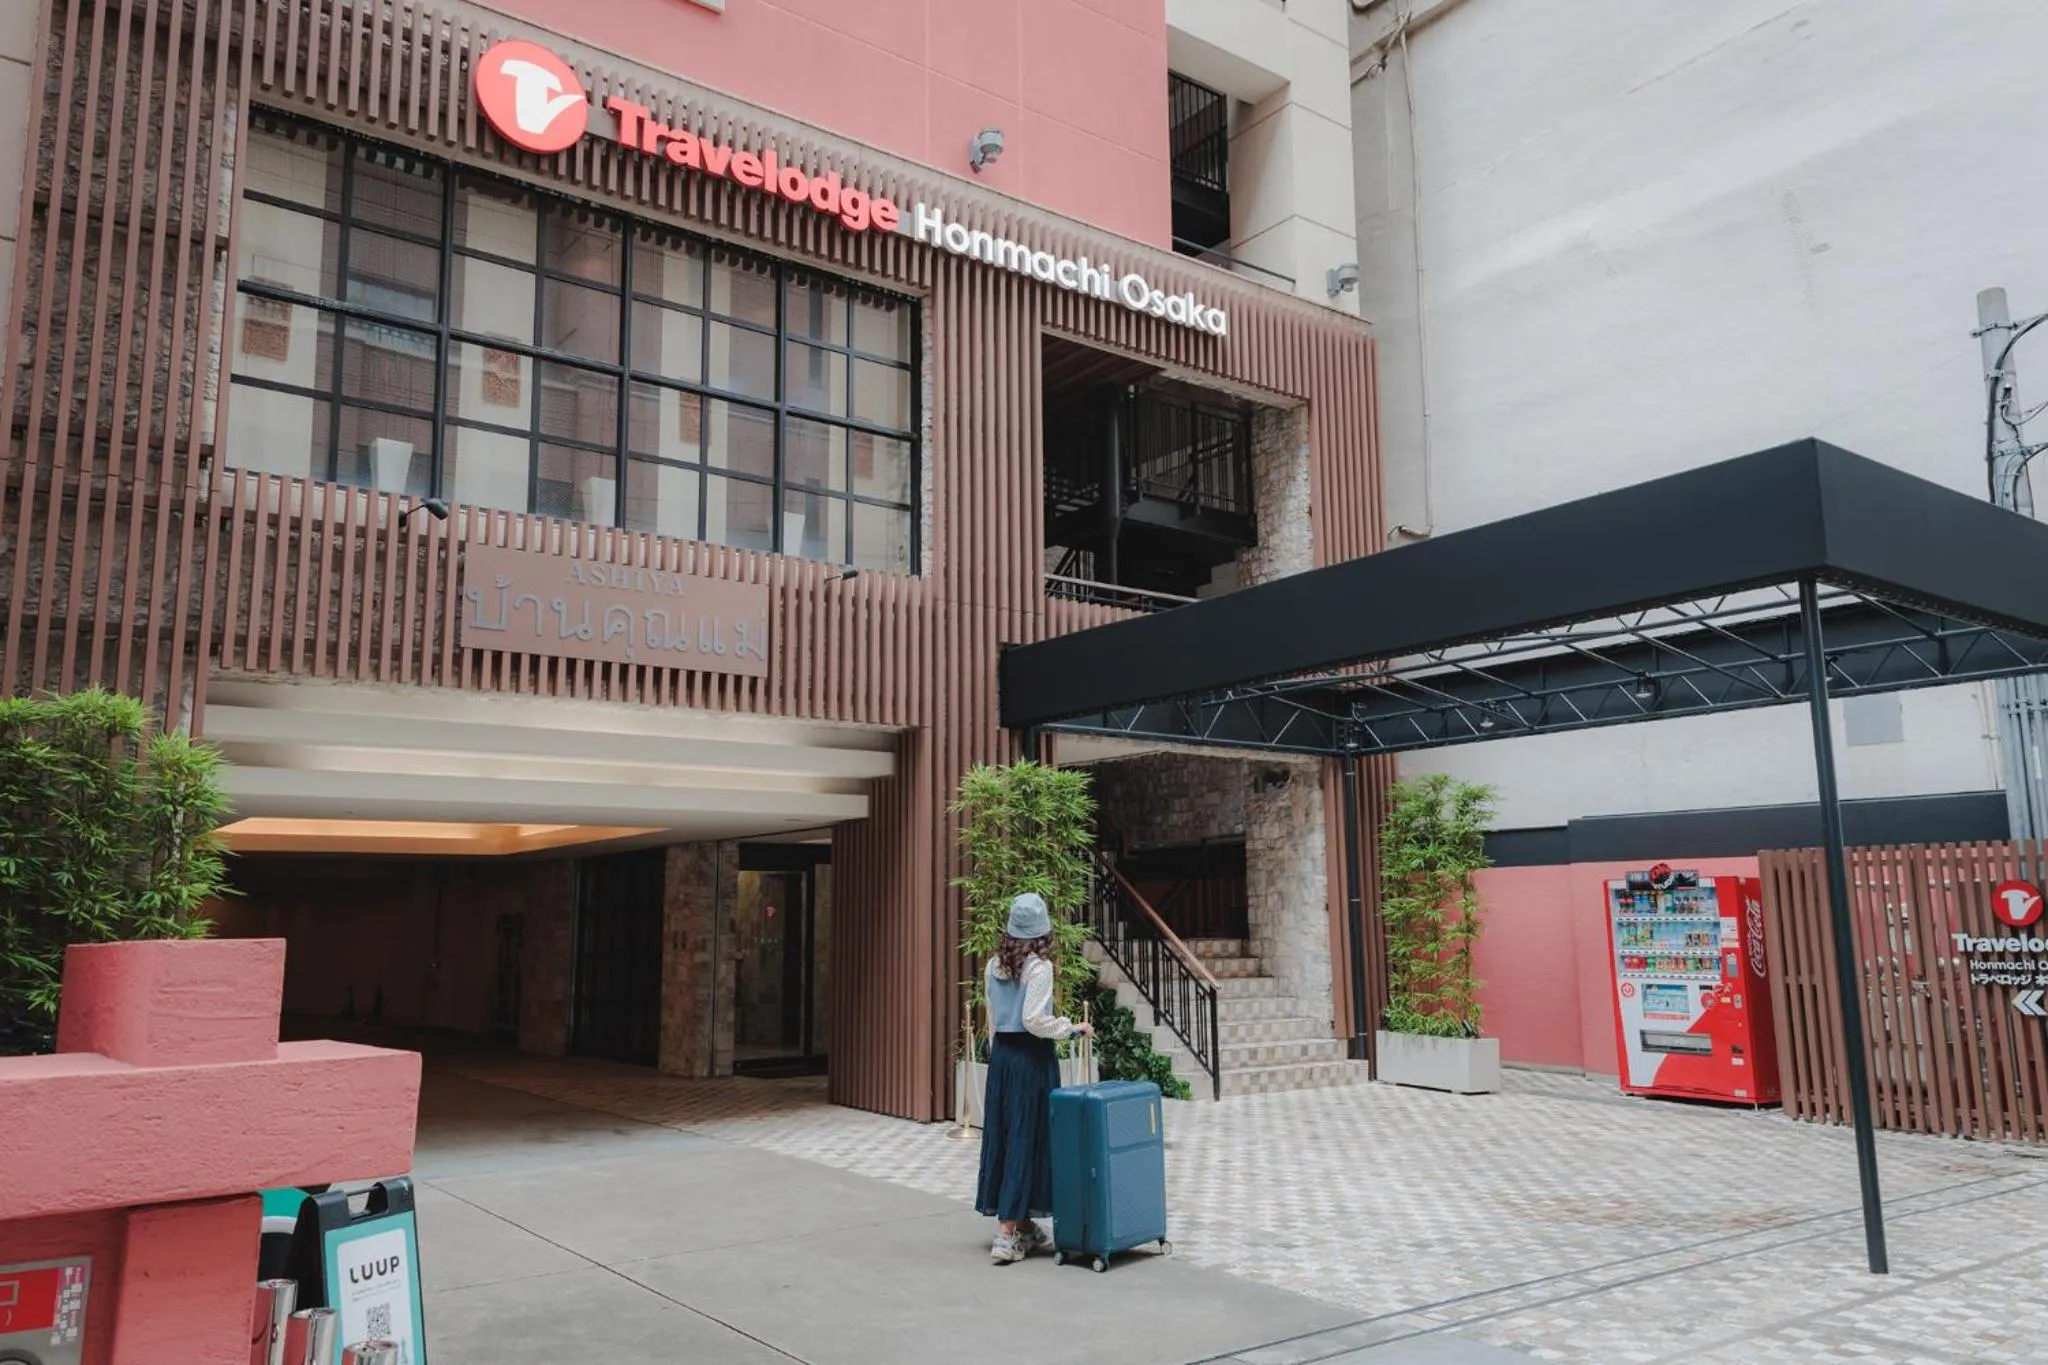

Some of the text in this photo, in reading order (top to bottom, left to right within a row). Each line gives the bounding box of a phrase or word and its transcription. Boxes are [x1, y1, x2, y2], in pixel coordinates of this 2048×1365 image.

[607, 96, 1228, 336] Travelodge Honmachi Osaka
[567, 562, 685, 597] ASHIYA
[1969, 959, 2036, 971] Honmachi
[349, 1255, 400, 1284] LUUP
